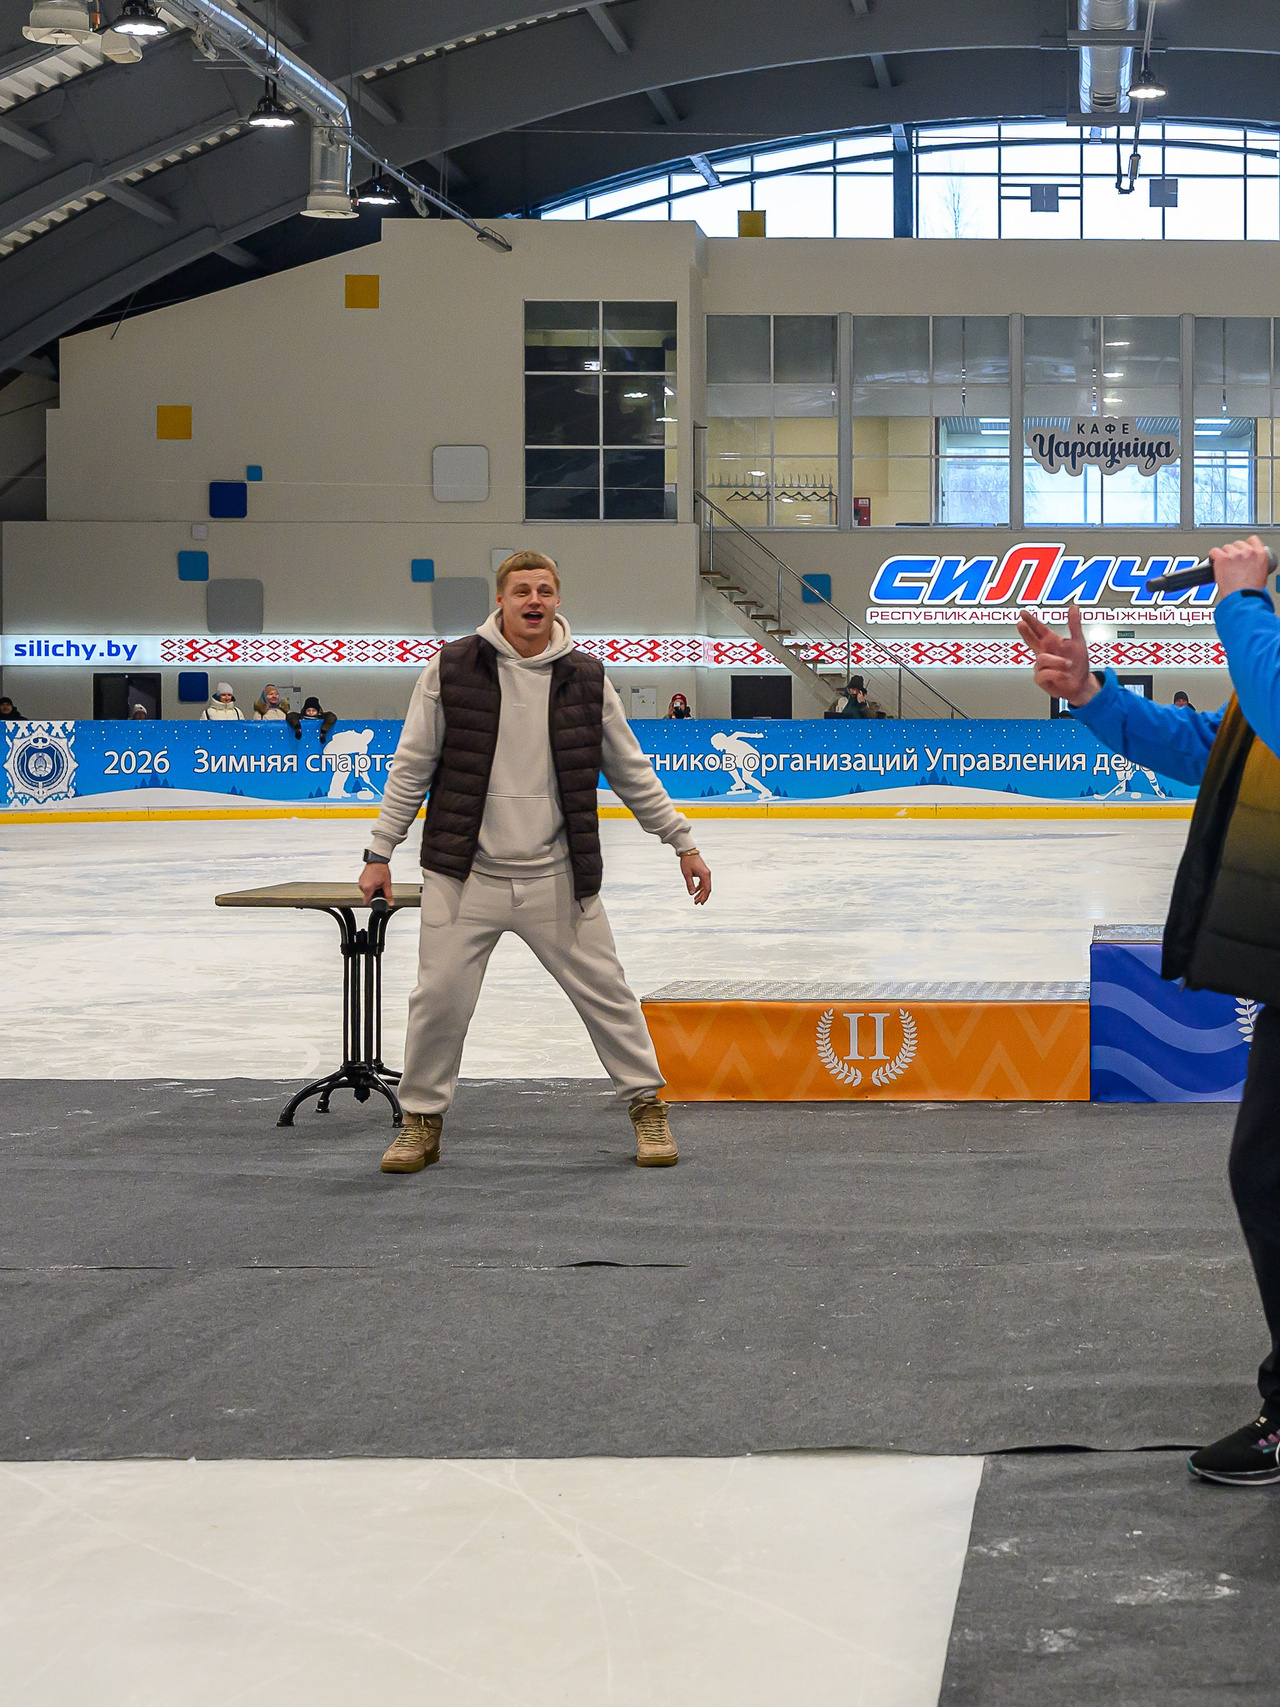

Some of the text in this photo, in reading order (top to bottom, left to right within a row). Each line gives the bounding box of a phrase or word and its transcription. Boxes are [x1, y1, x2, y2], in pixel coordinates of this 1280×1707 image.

[1077, 423, 1130, 435] КАФЕ
[1042, 609, 1175, 621] ГОРОЛЫЖНЫЙ
[1179, 611, 1215, 623] ЦЕН
[14, 640, 138, 661] silichy.by
[103, 750, 170, 774] 2026
[193, 748, 298, 774] Зимняя
[743, 747, 918, 777] организаций
[924, 747, 1086, 777] Управления
[842, 1012, 891, 1060] II
